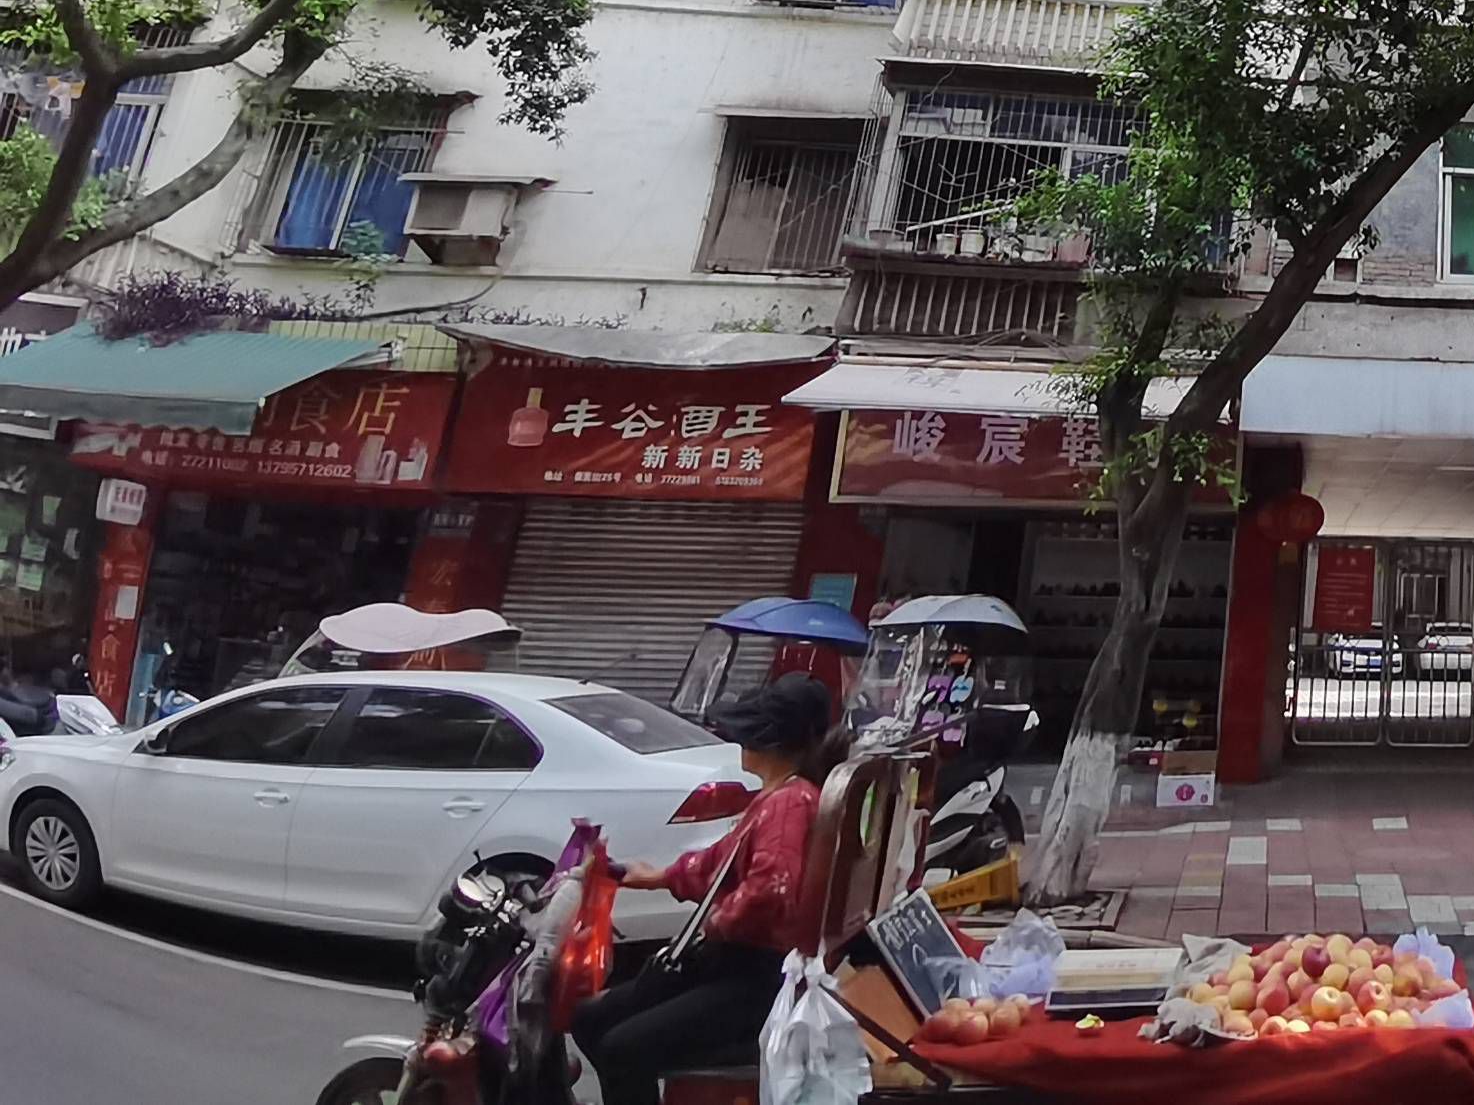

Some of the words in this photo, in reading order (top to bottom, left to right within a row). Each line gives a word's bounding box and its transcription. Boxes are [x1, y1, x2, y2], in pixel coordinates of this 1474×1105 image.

[260, 382, 411, 438] 食店
[640, 443, 766, 472] 新新日杂
[891, 409, 1106, 469] 峻宸鞋
